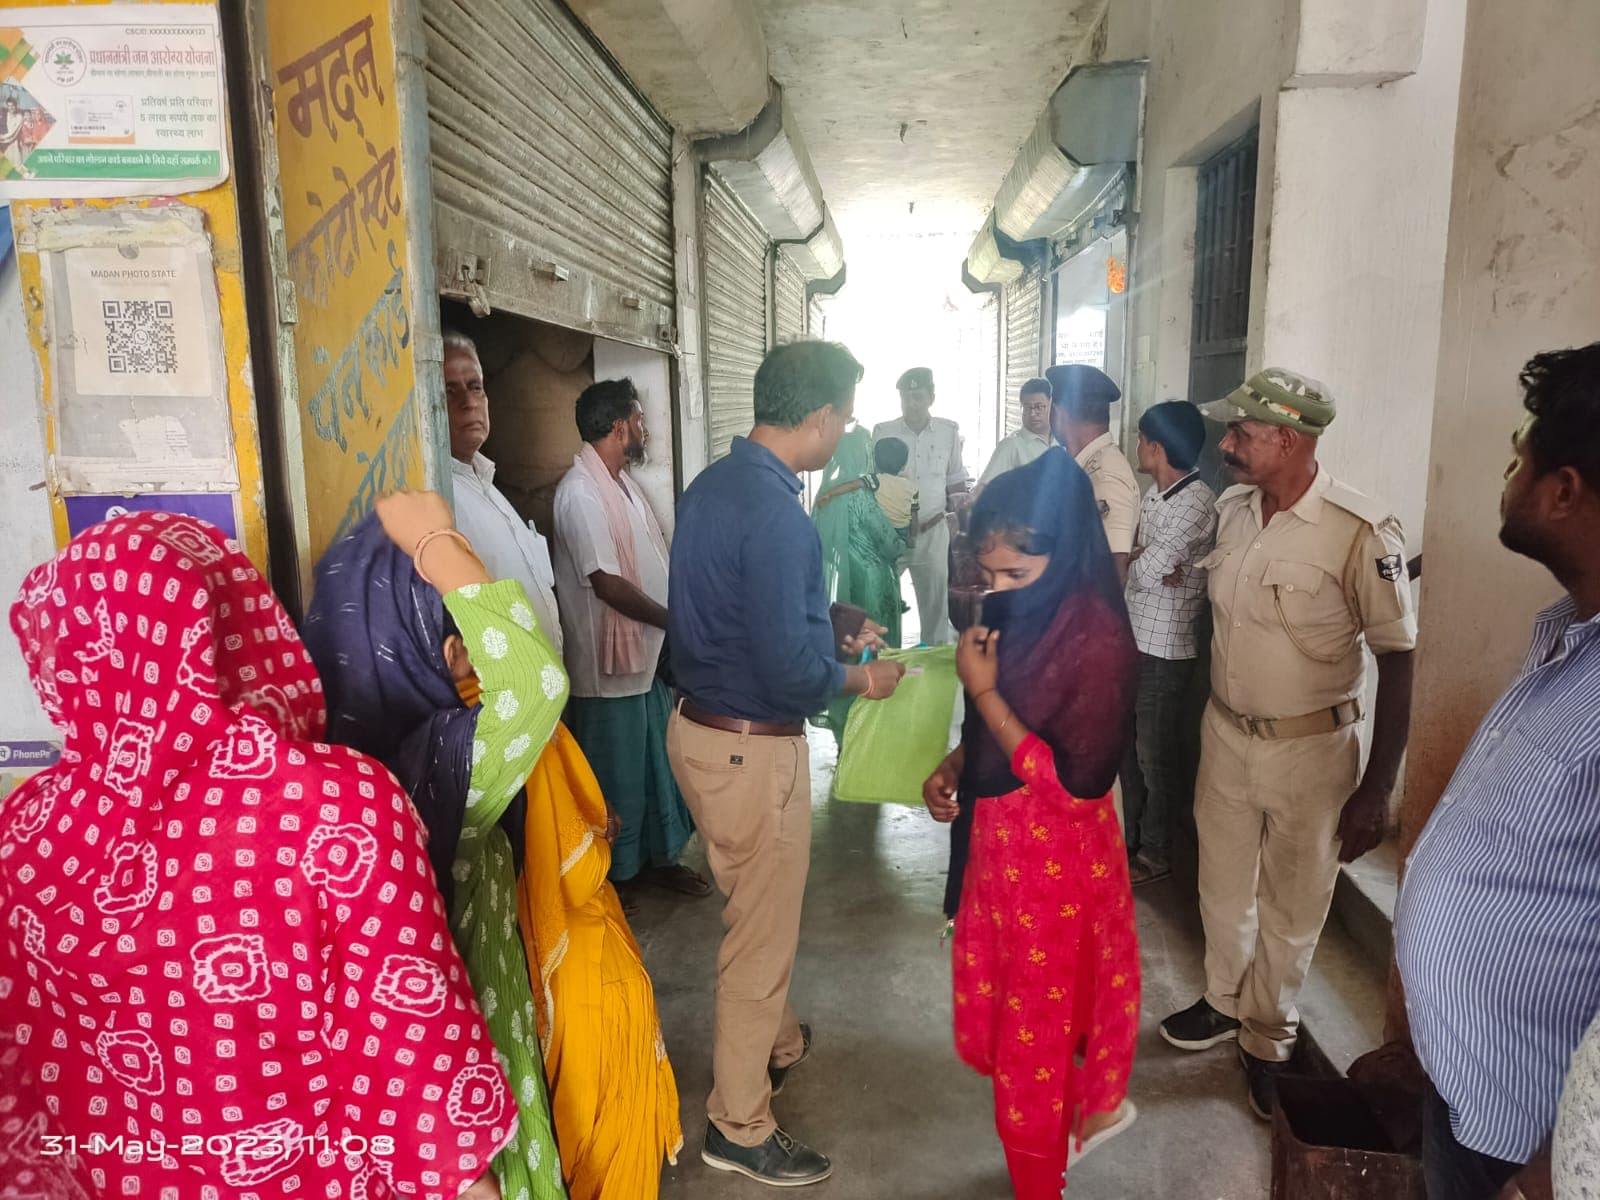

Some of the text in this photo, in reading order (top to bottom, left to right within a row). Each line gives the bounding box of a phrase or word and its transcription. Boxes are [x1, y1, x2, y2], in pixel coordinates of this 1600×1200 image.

[90, 43, 131, 65] प्रधानमंत्री
[132, 50, 148, 65] जन
[150, 45, 183, 65] आरोग्य
[184, 44, 215, 65] योजना
[277, 14, 385, 143] मदन
[90, 270, 176, 278] MADAN PHOTO STATE
